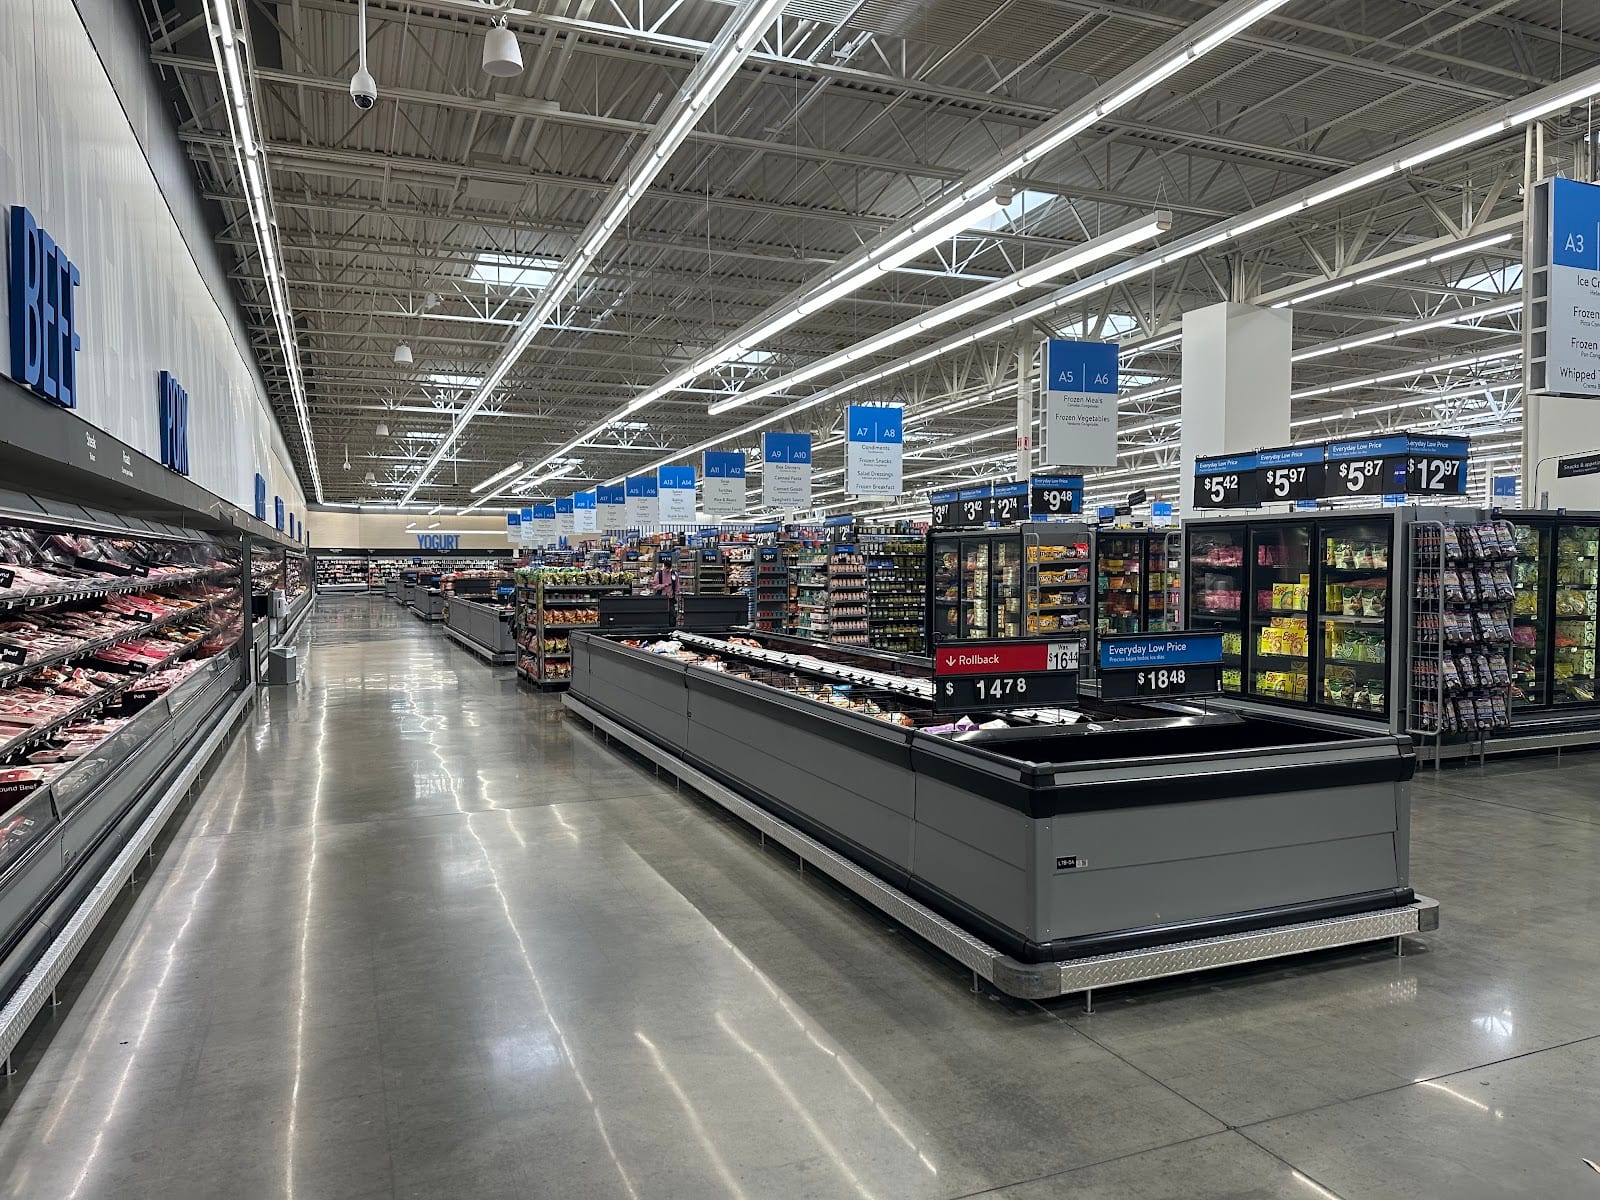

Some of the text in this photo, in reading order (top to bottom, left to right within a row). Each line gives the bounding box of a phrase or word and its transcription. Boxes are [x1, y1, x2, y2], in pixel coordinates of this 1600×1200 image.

[1564, 232, 1584, 253] A3
[1577, 274, 1589, 287] Ice
[10, 205, 80, 409] BEEF
[1573, 305, 1600, 320] Frozen
[1571, 337, 1598, 350] Frozen
[1058, 370, 1109, 385] A5 A6
[1559, 366, 1596, 382] Whipped
[1063, 394, 1103, 404] Frozen Meals
[1055, 413, 1110, 423] Frozen Vegetables
[856, 427, 896, 438] A7 A8
[1332, 445, 1356, 453] Everyday
[1407, 440, 1426, 448] veryday
[771, 450, 807, 459] A9 A10
[417, 534, 461, 550] YOGURT
[1057, 643, 1069, 651] Was
[1109, 642, 1187, 656] Everyday Low Price
[959, 653, 1000, 665] Rollback
[19, 783, 38, 791] Beef
